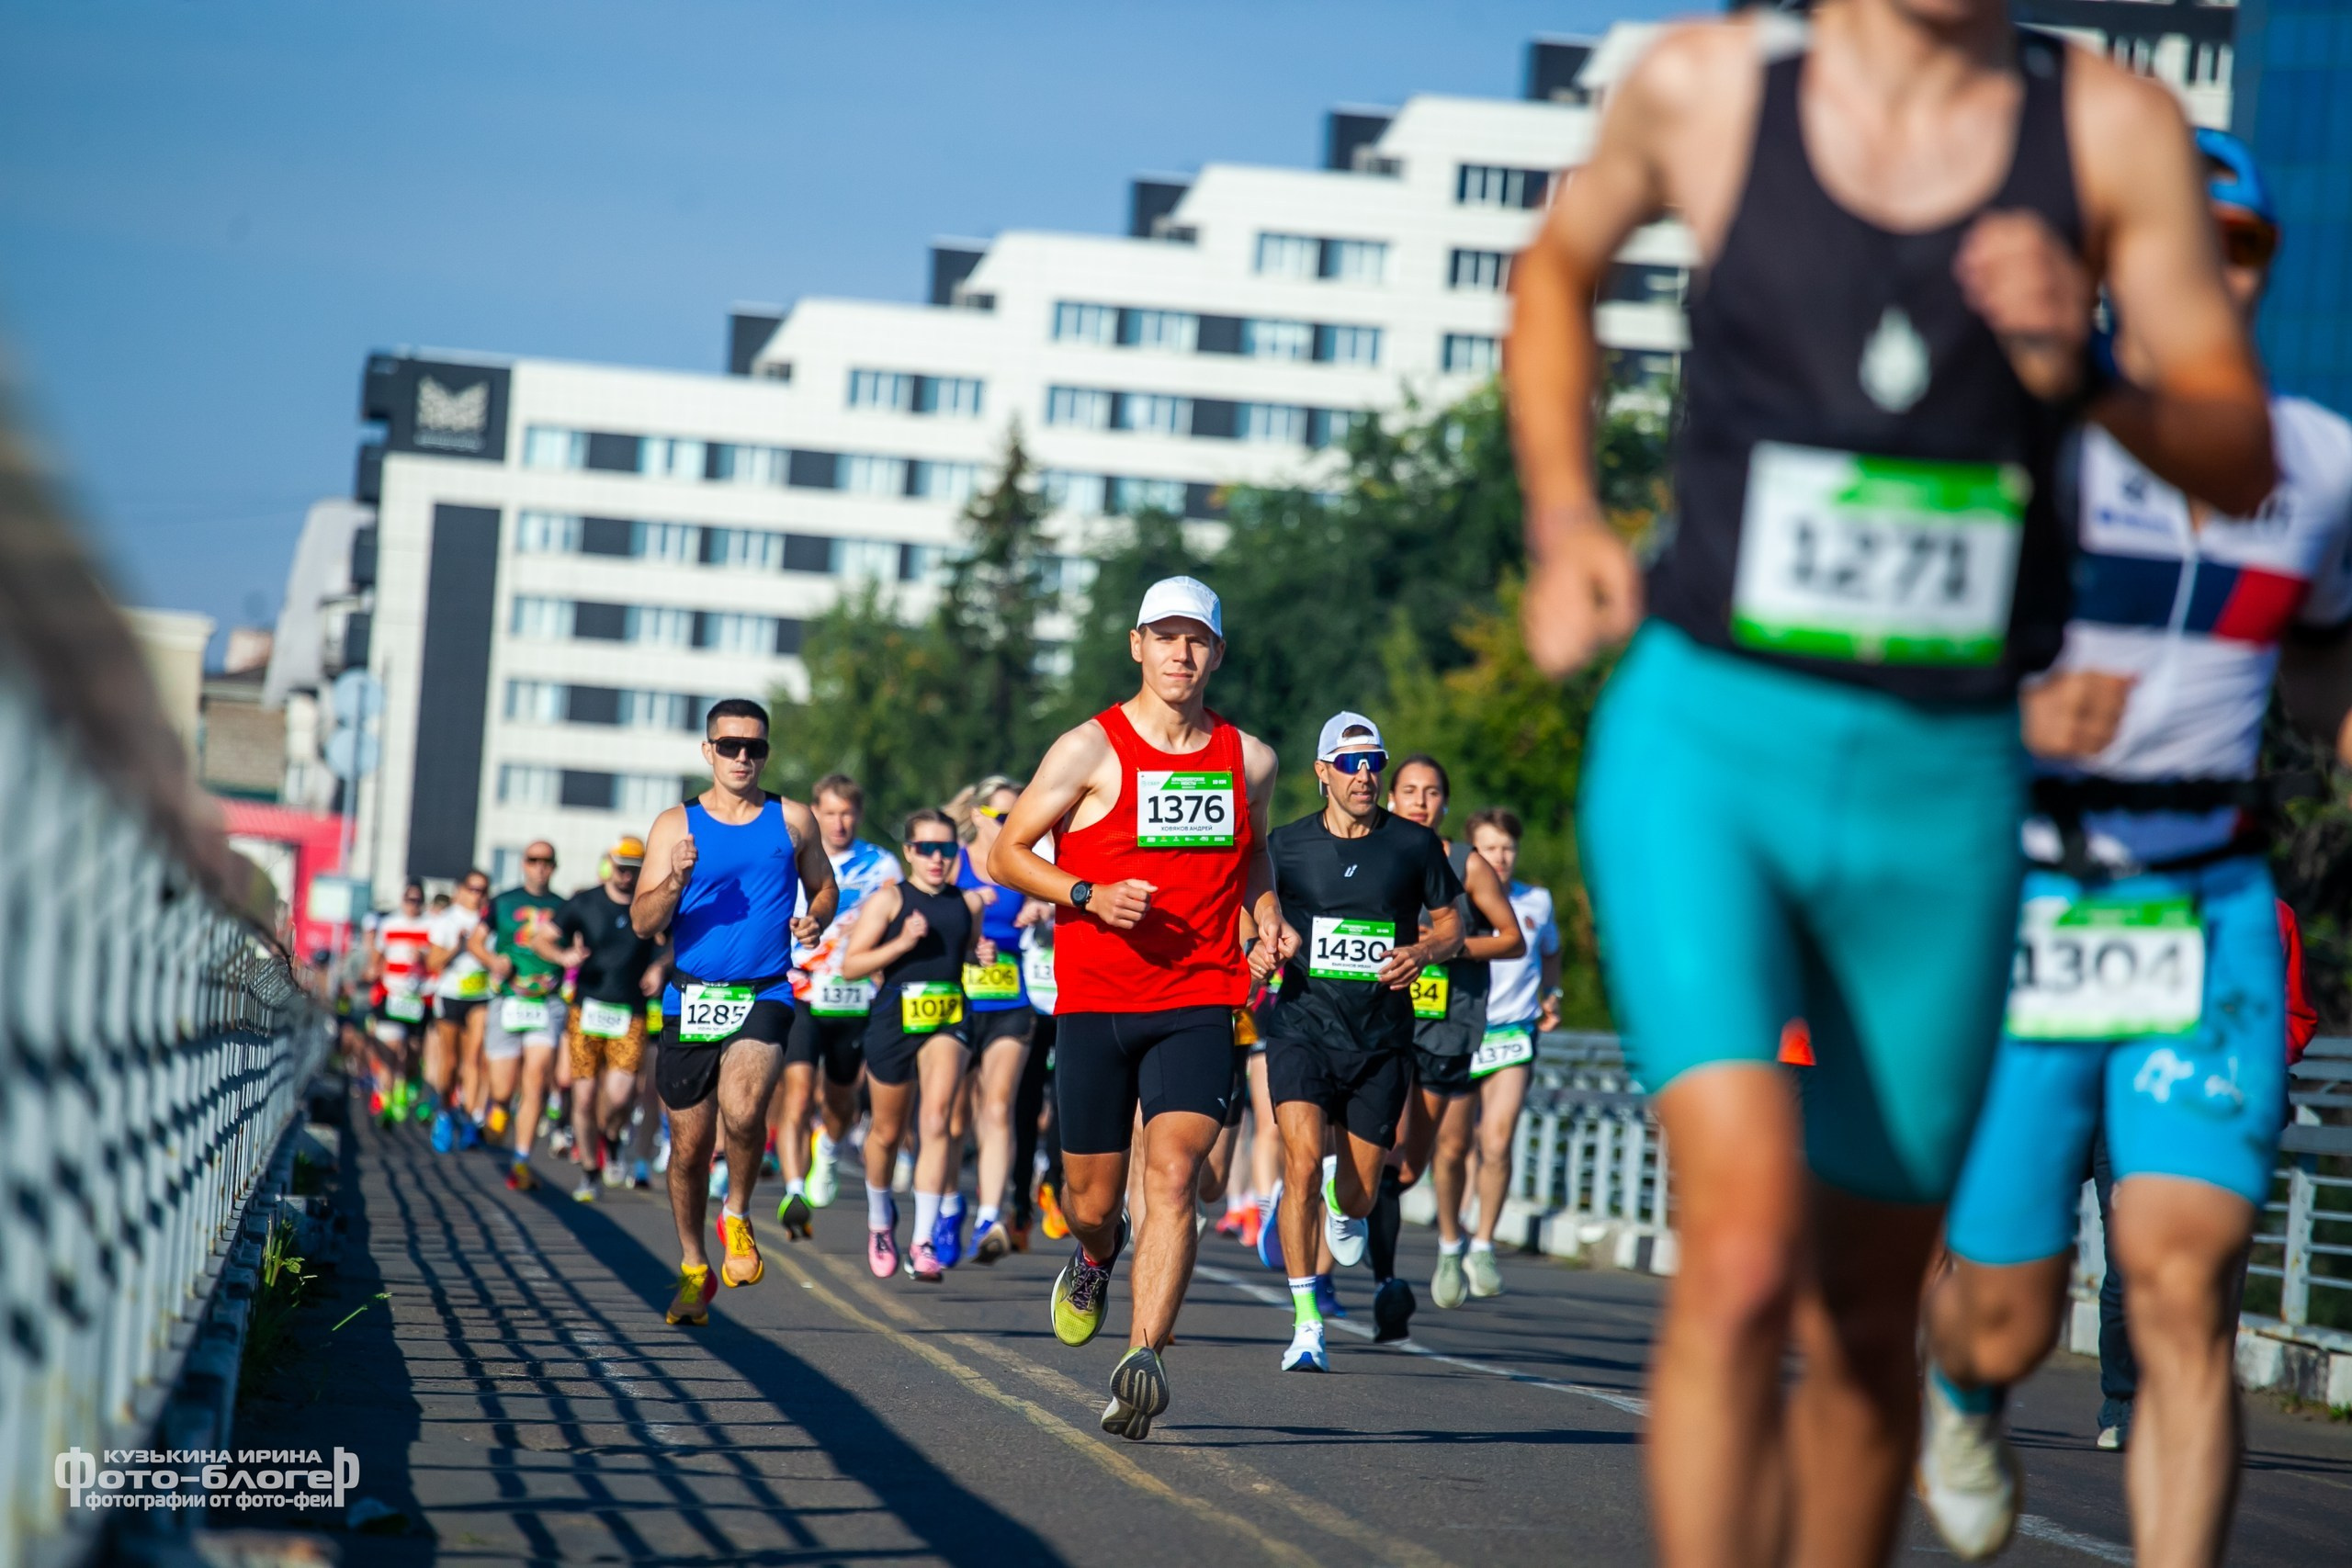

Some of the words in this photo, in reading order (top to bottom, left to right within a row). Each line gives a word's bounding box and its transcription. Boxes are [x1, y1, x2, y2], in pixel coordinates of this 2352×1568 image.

[1790, 518, 1969, 603] 1271
[1148, 795, 1225, 823] 1376
[1317, 938, 1387, 964] 1430
[2015, 939, 2186, 998] 1304
[687, 1004, 746, 1025] 1285
